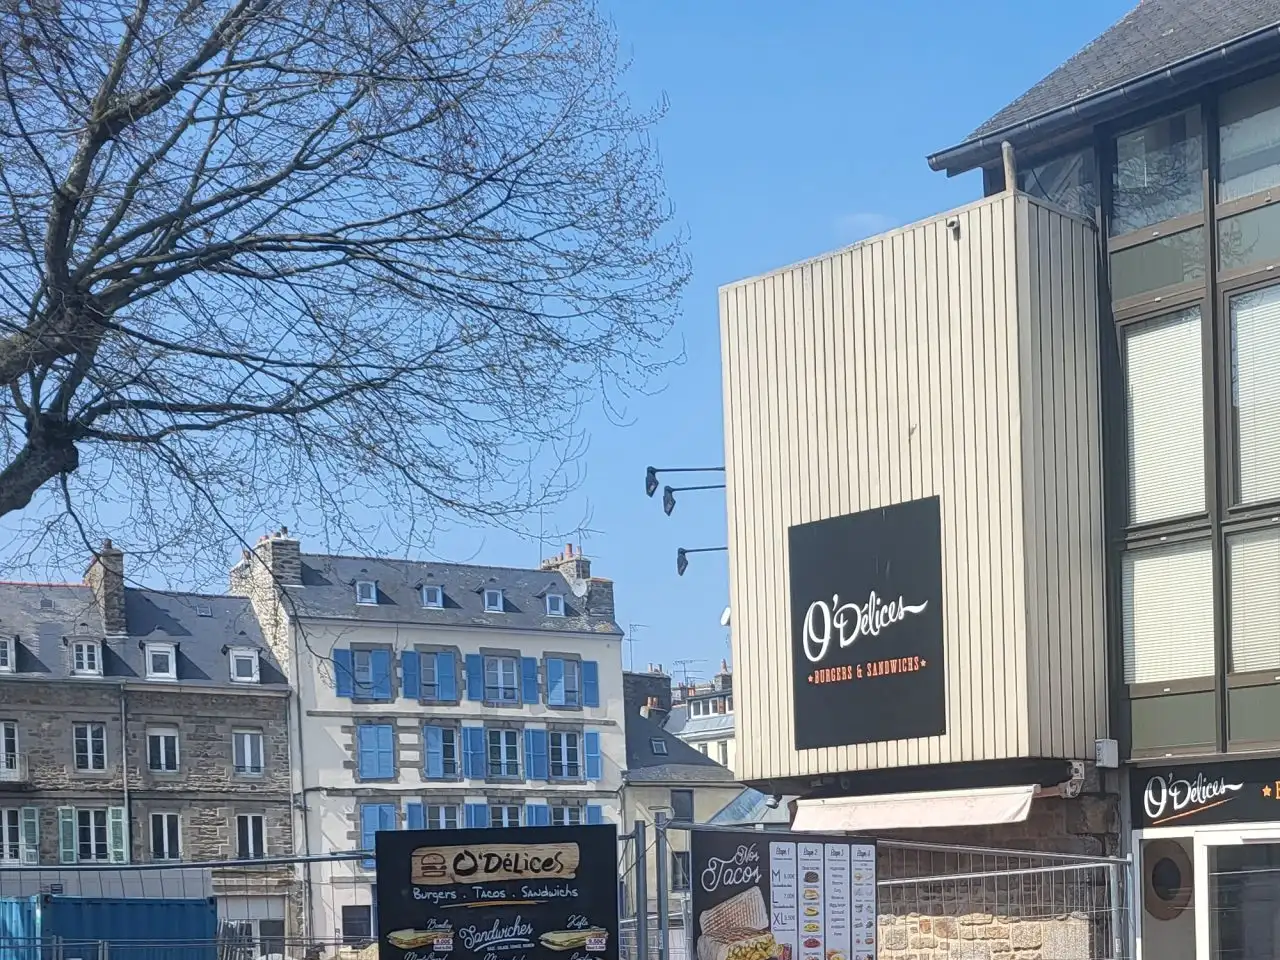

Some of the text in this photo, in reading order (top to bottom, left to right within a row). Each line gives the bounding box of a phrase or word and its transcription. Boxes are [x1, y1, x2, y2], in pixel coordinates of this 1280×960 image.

[803, 590, 928, 662] O'Délices
[814, 656, 920, 684] BURGERS & SANDWICHS
[1144, 772, 1244, 819] O'Délices
[733, 843, 760, 865] Nos
[701, 857, 762, 892] Tacos
[772, 869, 780, 882] M
[413, 888, 457, 904] Burgers
[772, 890, 779, 903] L
[773, 912, 787, 925] XL
[459, 915, 533, 949] Sandwiches
